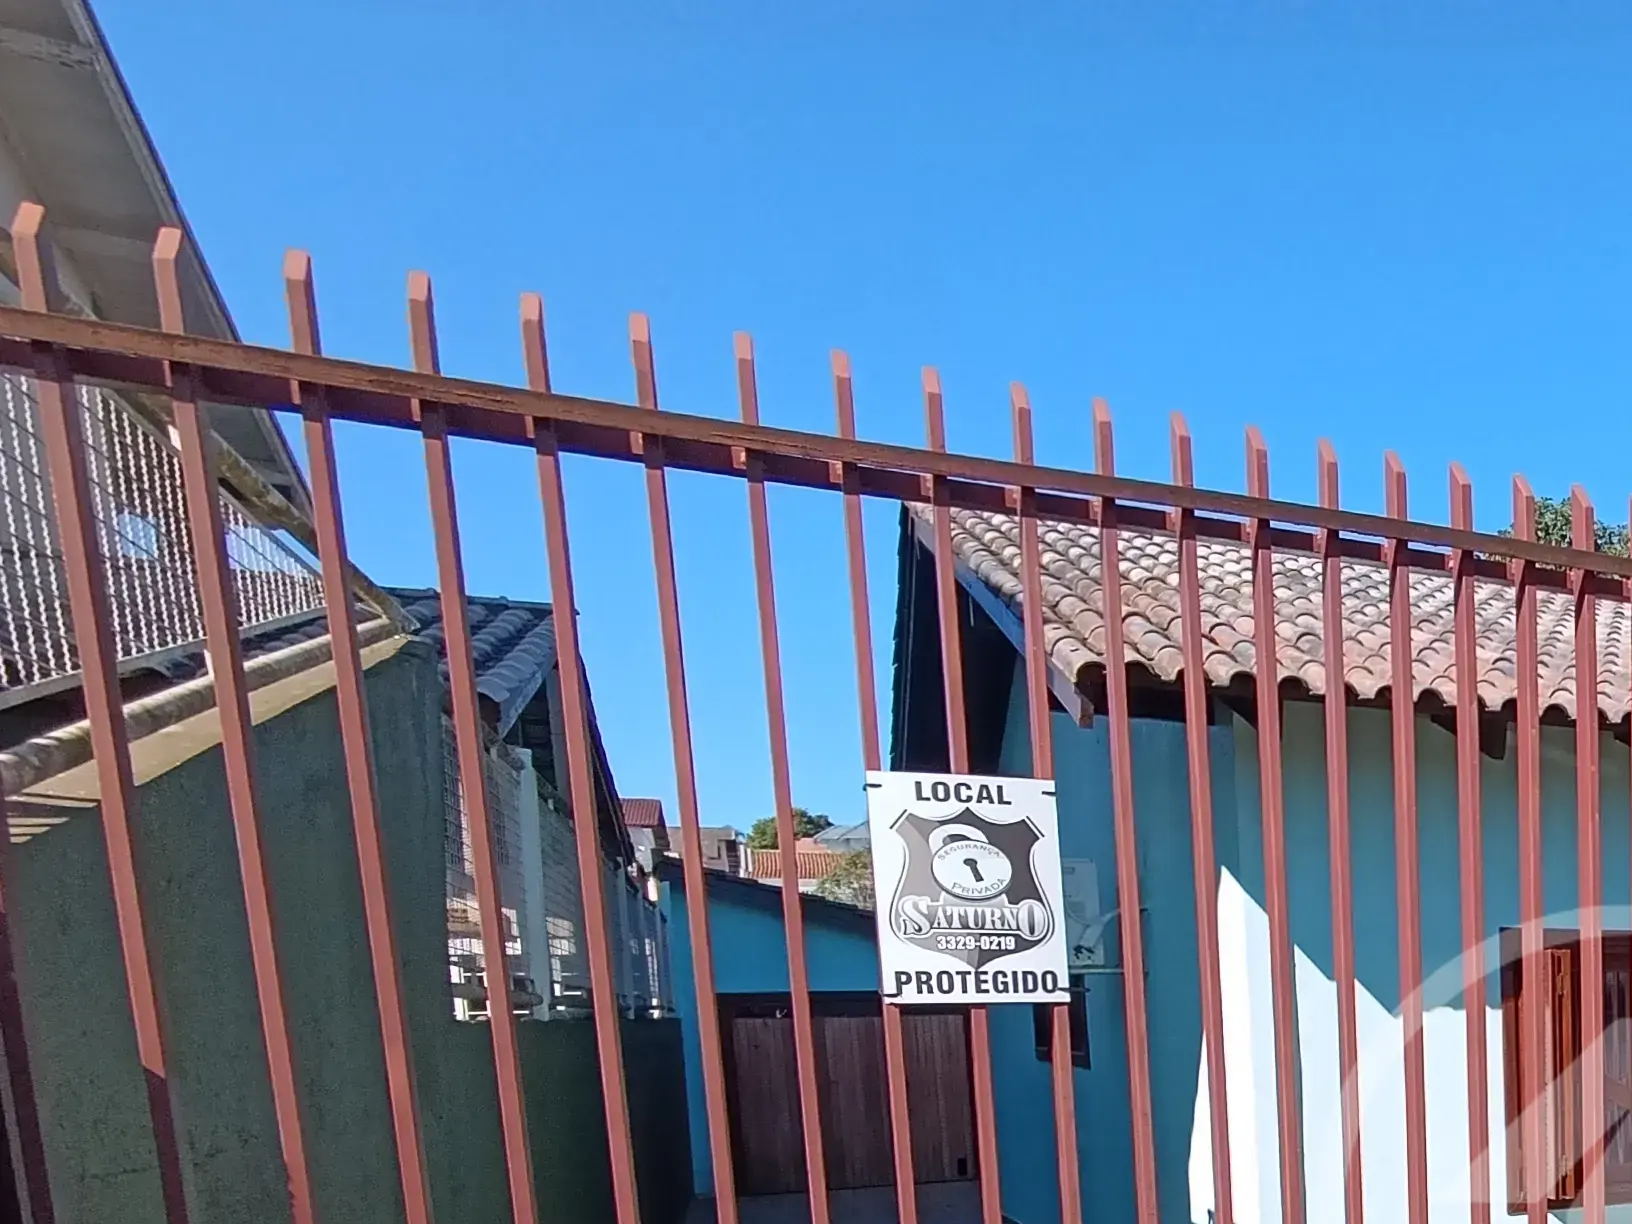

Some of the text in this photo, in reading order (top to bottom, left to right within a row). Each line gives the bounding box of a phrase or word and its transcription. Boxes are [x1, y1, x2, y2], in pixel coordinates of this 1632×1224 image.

[914, 781, 1012, 806] LOCAL
[937, 843, 1004, 861] SEGURANÇA
[951, 878, 1007, 895] PRIVADA
[899, 896, 1047, 938] SATURNO
[936, 935, 1015, 951] 3329-0219
[894, 970, 1059, 994] PROTEGIDO
